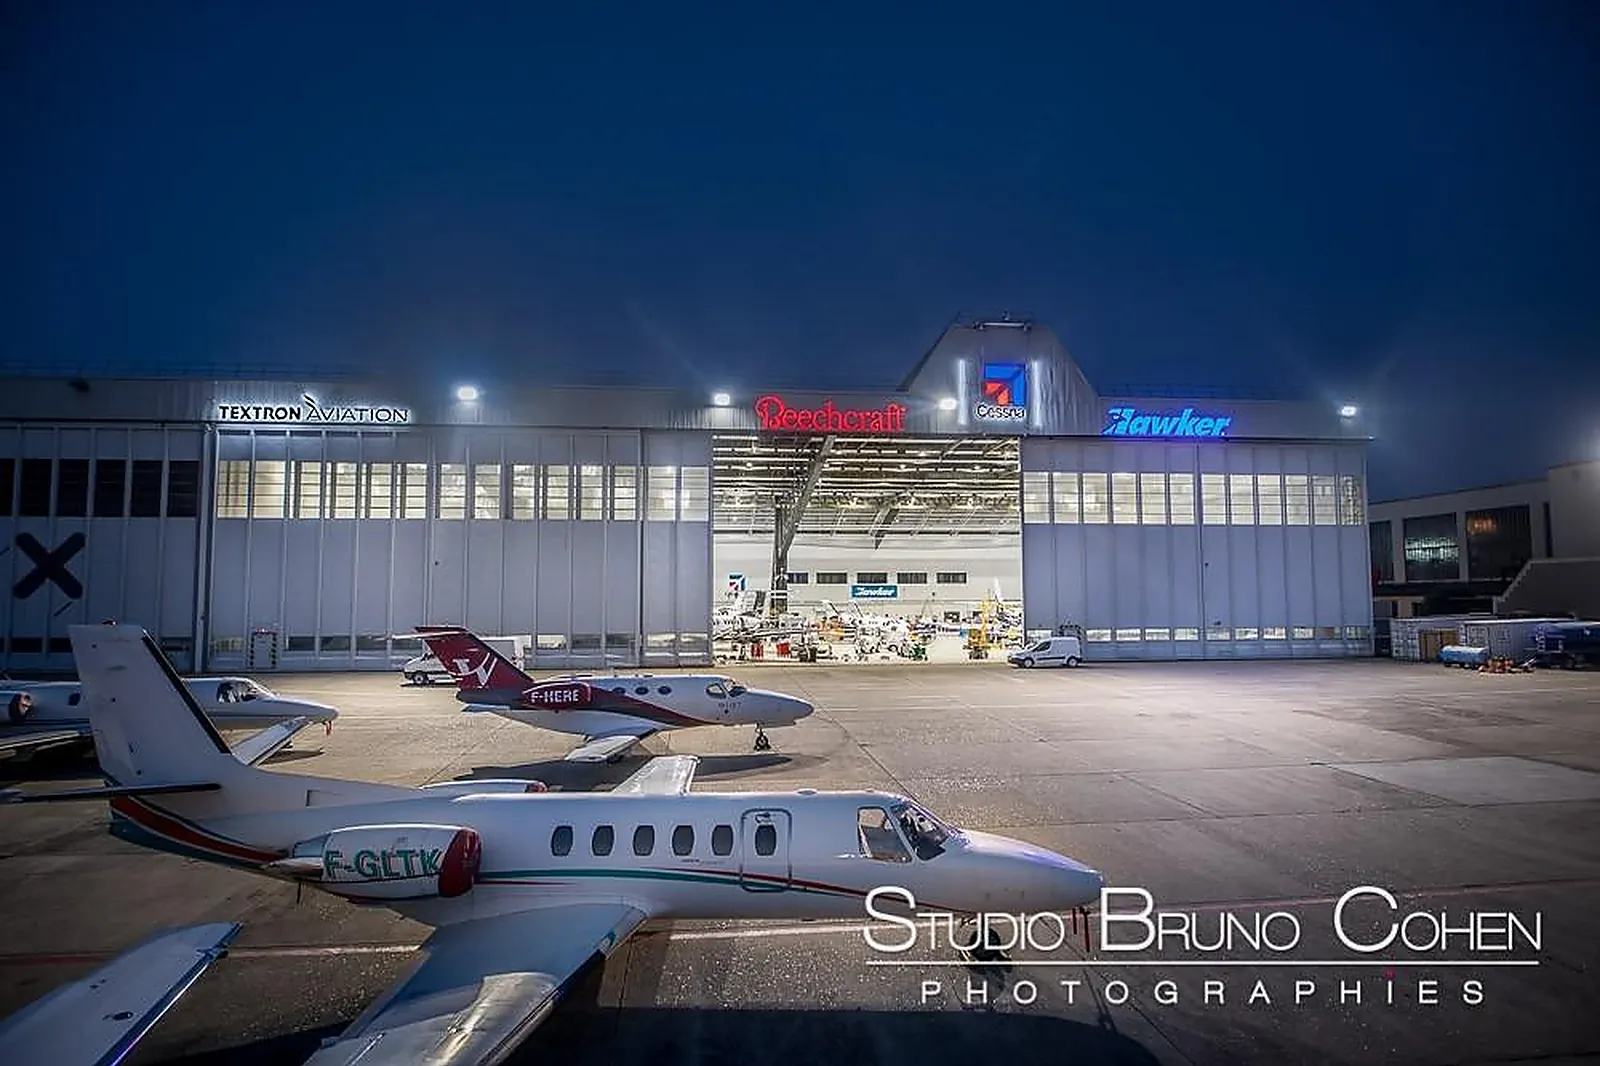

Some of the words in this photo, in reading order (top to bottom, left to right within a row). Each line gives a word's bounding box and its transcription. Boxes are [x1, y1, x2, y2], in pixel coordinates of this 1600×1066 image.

[219, 406, 301, 420] TEXTRON
[303, 396, 408, 422] AVIATION
[755, 395, 907, 431] Beechcraft
[976, 404, 1025, 419] Cessna
[1102, 408, 1231, 436] Hawker
[530, 689, 580, 703] F-HERE
[324, 849, 443, 879] F-GLTK
